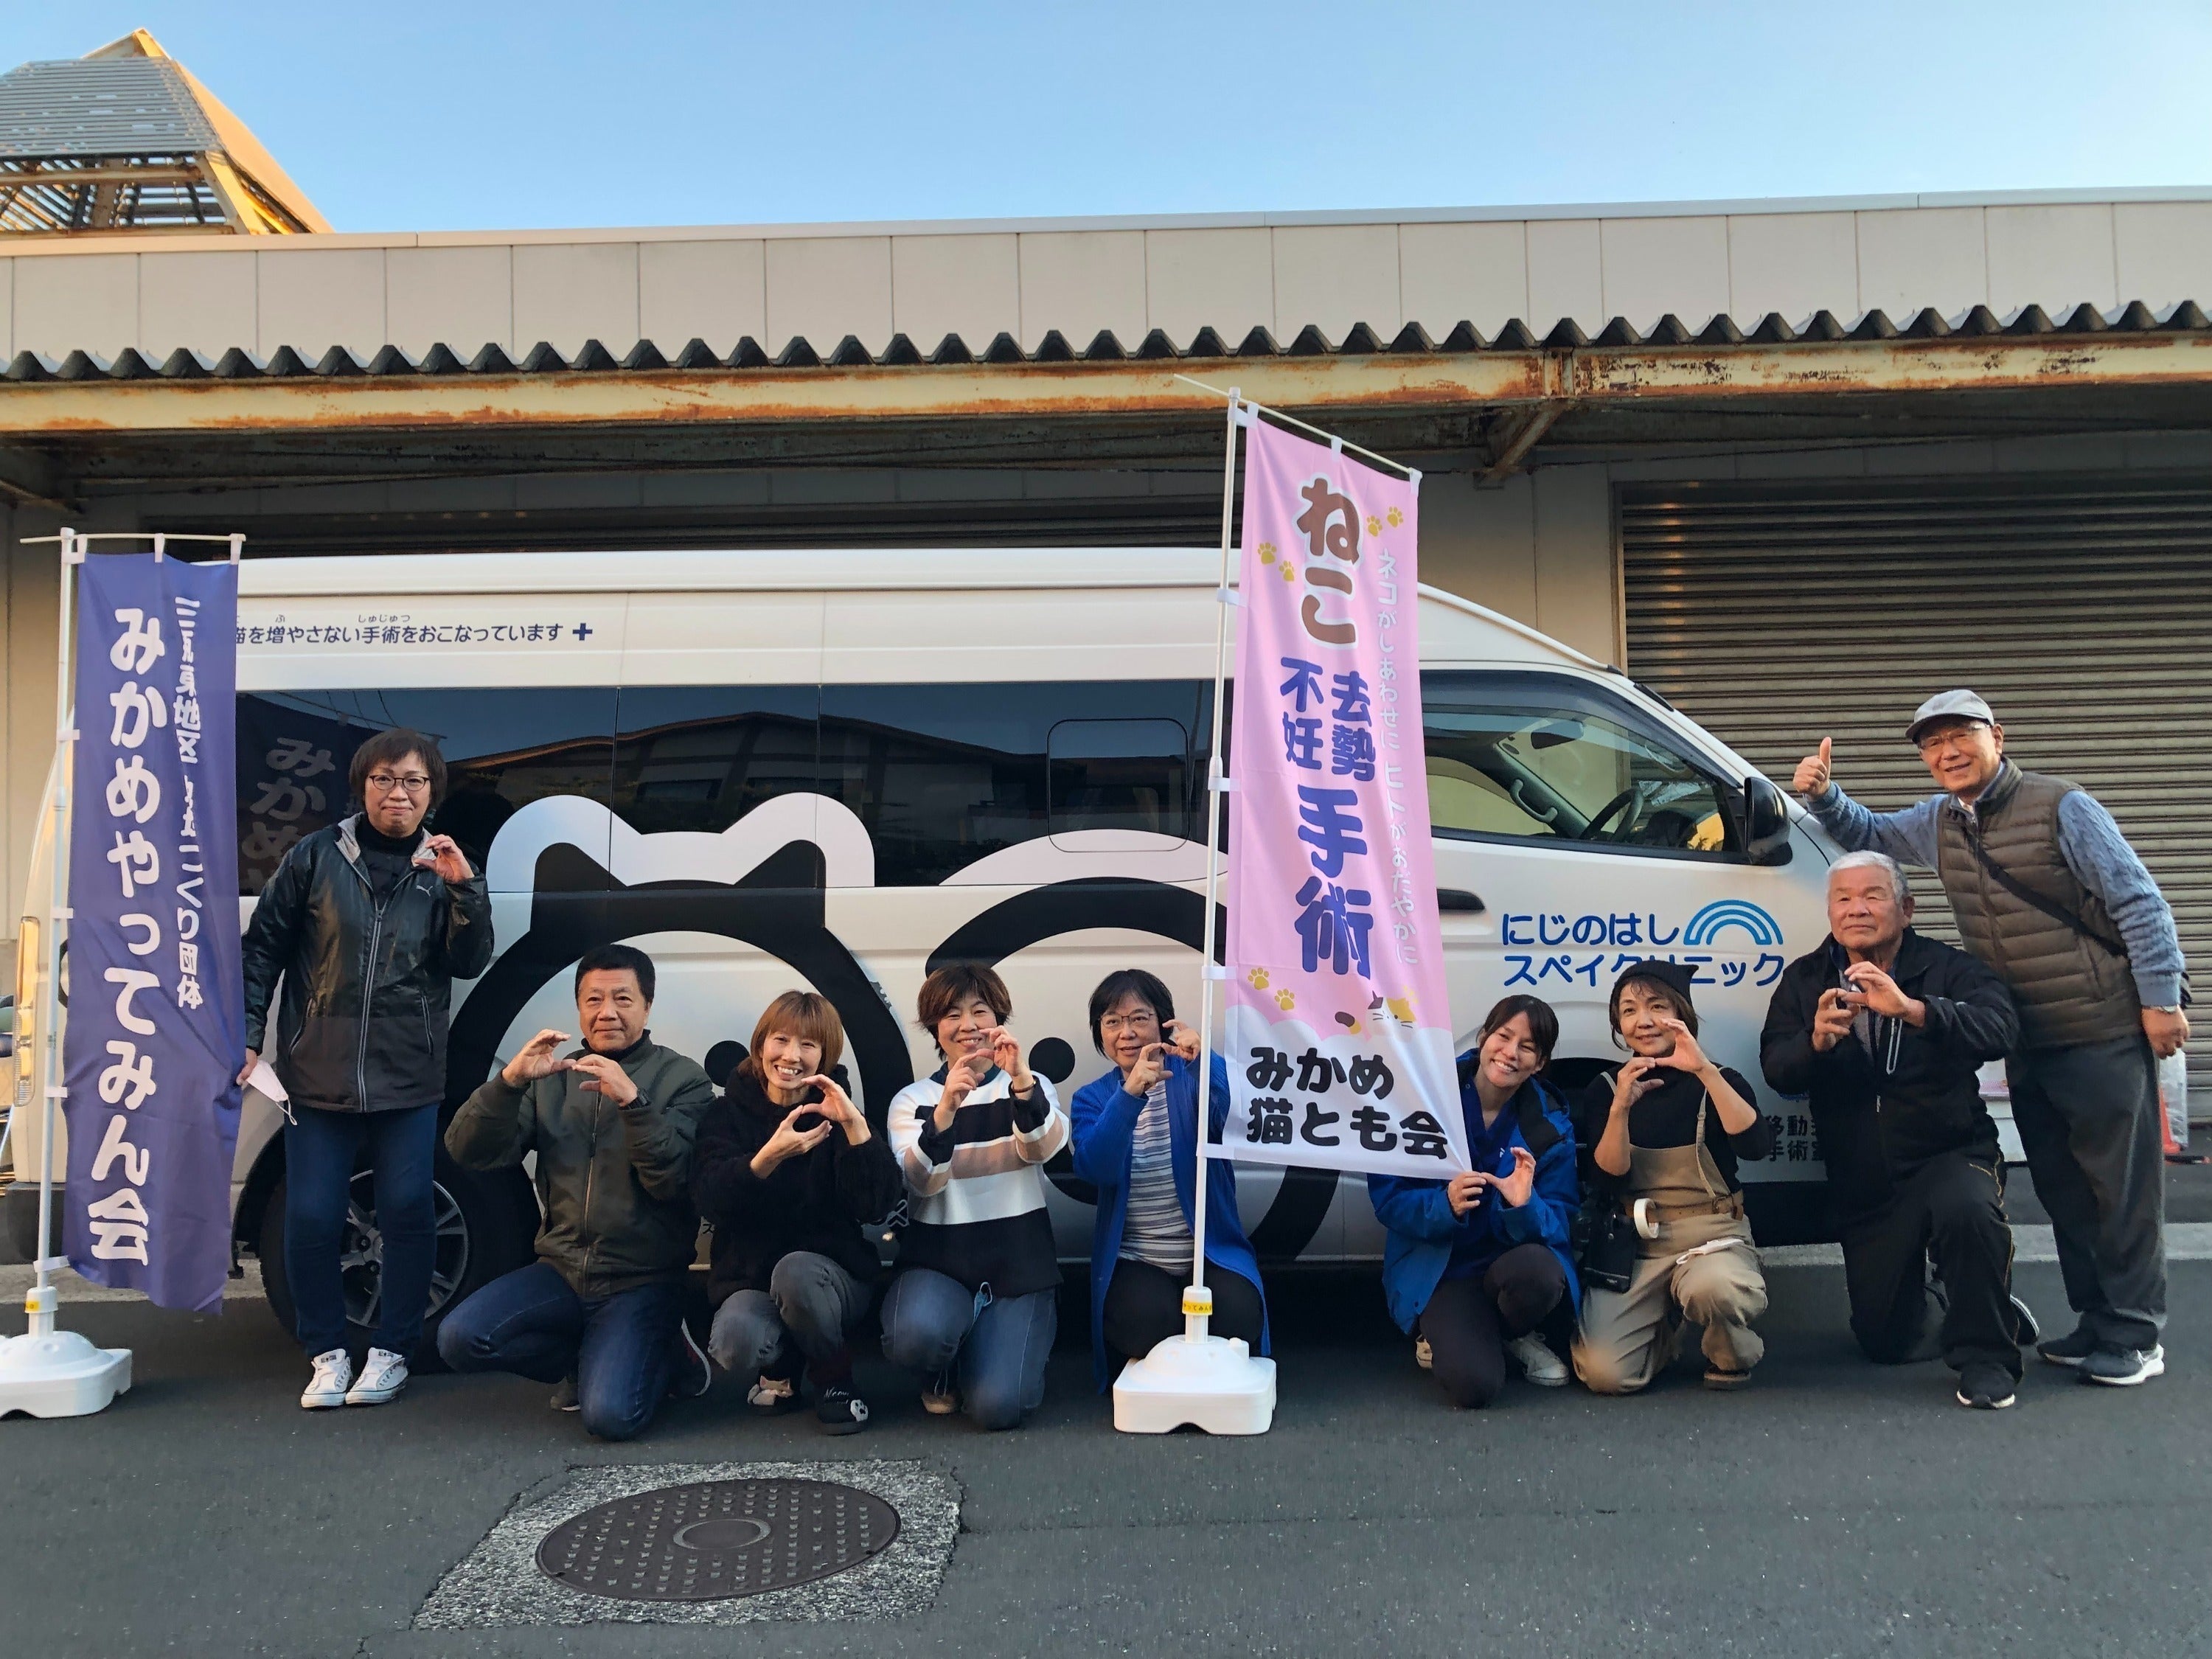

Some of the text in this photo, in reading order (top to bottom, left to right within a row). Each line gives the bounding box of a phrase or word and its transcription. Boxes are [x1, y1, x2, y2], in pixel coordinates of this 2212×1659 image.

[1295, 475, 1361, 647] ねこ
[275, 614, 285, 622] ふ
[358, 614, 411, 623] しゅじゅつ
[1377, 548, 1399, 748] ネコがしあわせに
[1280, 656, 1324, 771] 不妊
[1332, 670, 1376, 782] 去勢
[1294, 784, 1374, 980] 手術
[87, 608, 167, 1265] みかめやってみん会
[1502, 913, 1680, 946] にじのはし
[1503, 953, 1784, 987] スペイクニック
[1246, 1047, 1394, 1100] みかめ
[1246, 1097, 1448, 1159] 猫とも会
